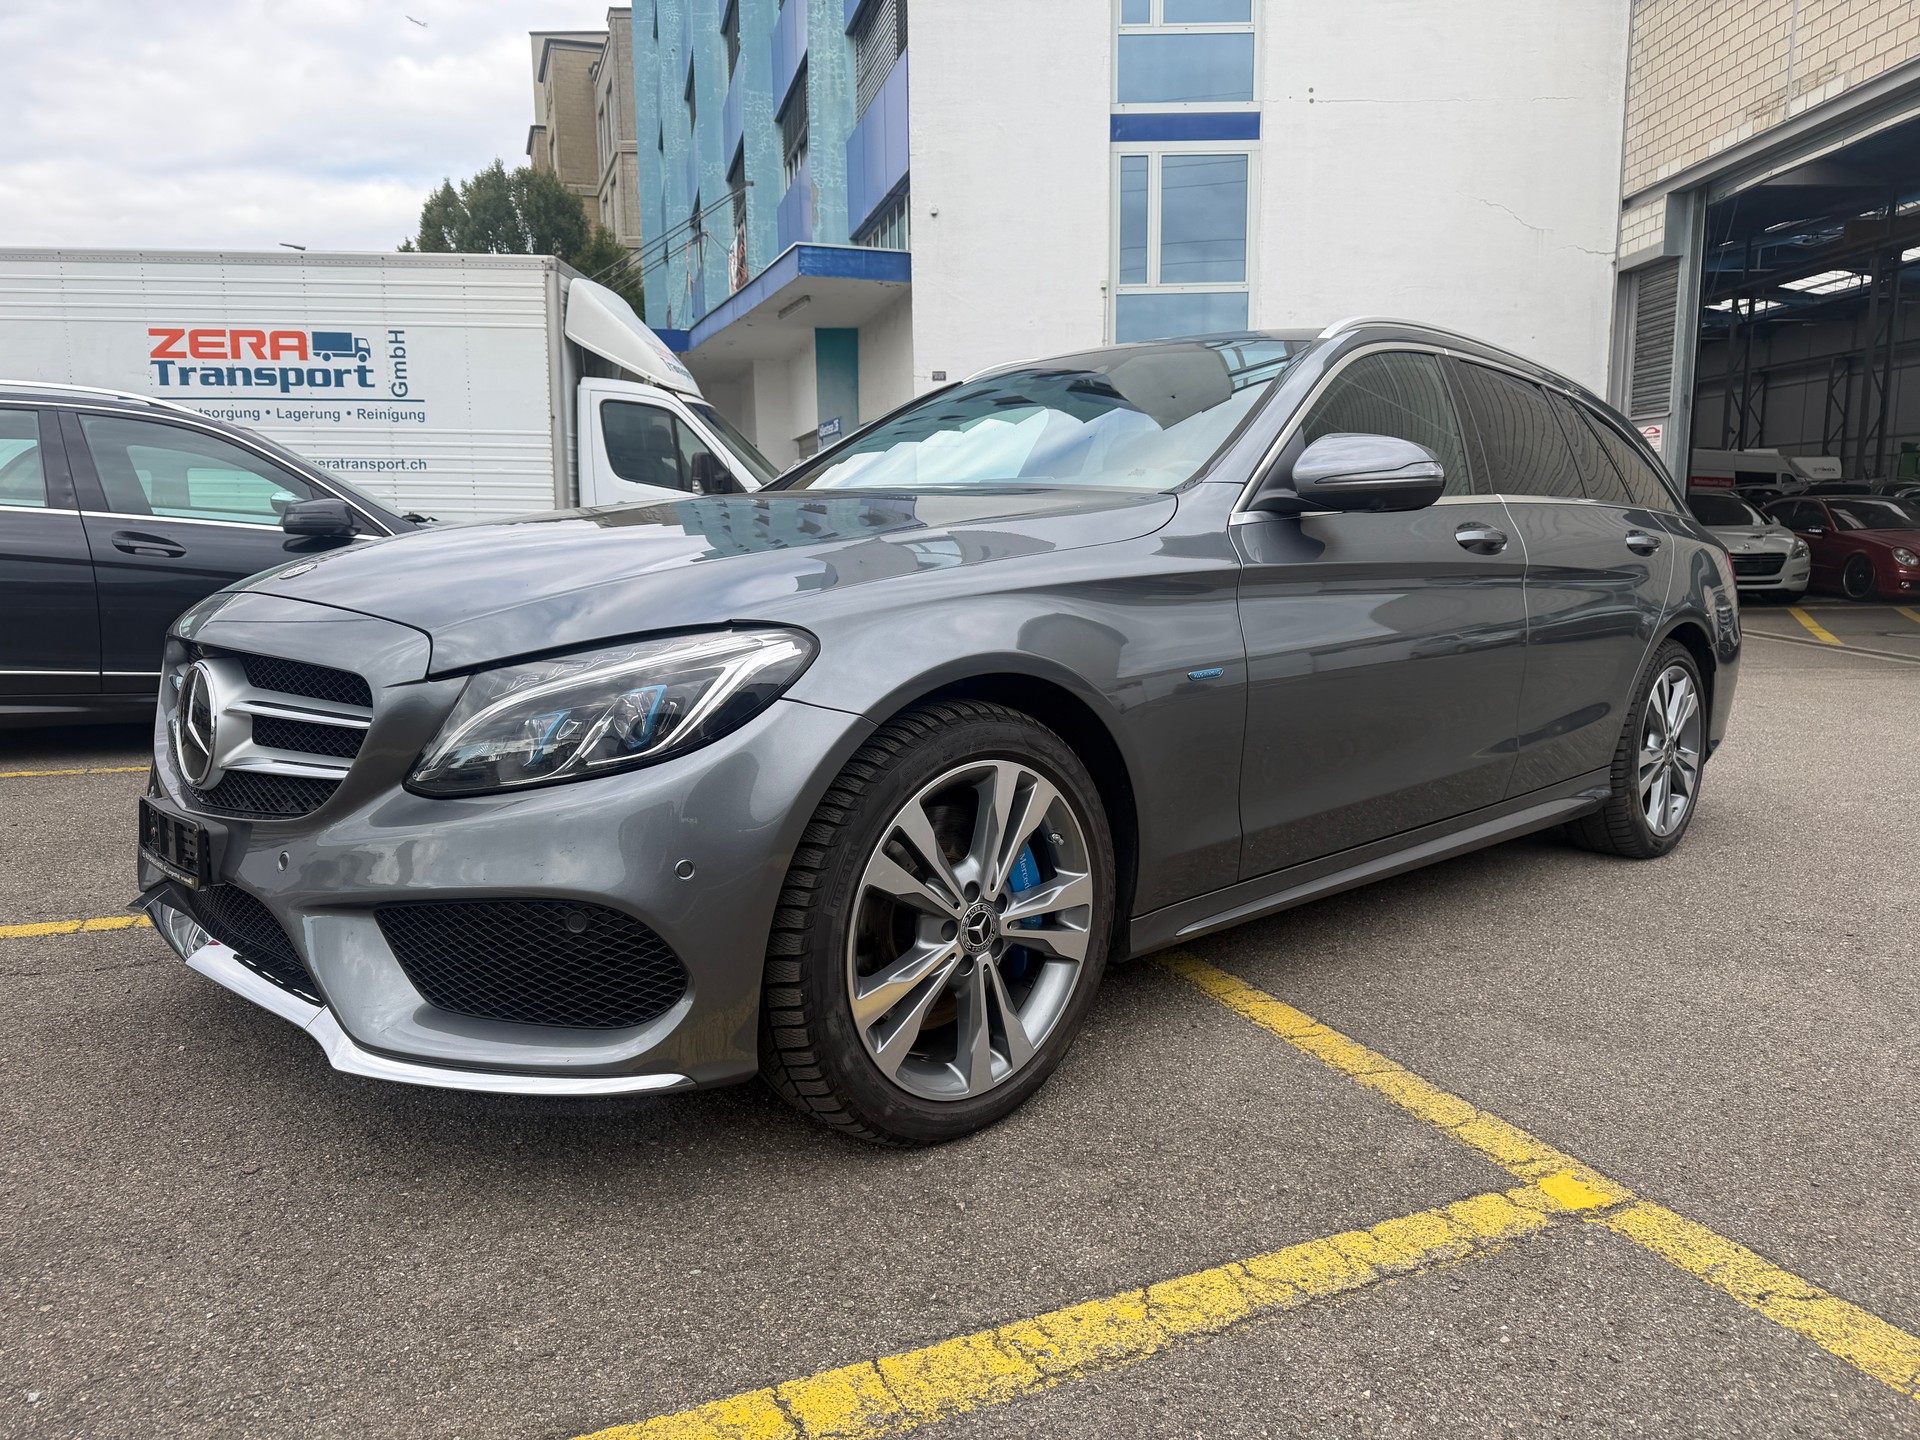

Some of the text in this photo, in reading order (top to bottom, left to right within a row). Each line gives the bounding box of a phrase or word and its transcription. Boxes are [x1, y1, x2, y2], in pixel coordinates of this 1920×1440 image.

[147, 327, 309, 361] ZERA
[150, 359, 376, 394] Transport
[386, 329, 409, 398] GmbH
[196, 406, 427, 423] tsorgung Lagerung Reinigung
[1019, 852, 1032, 889] Merced
